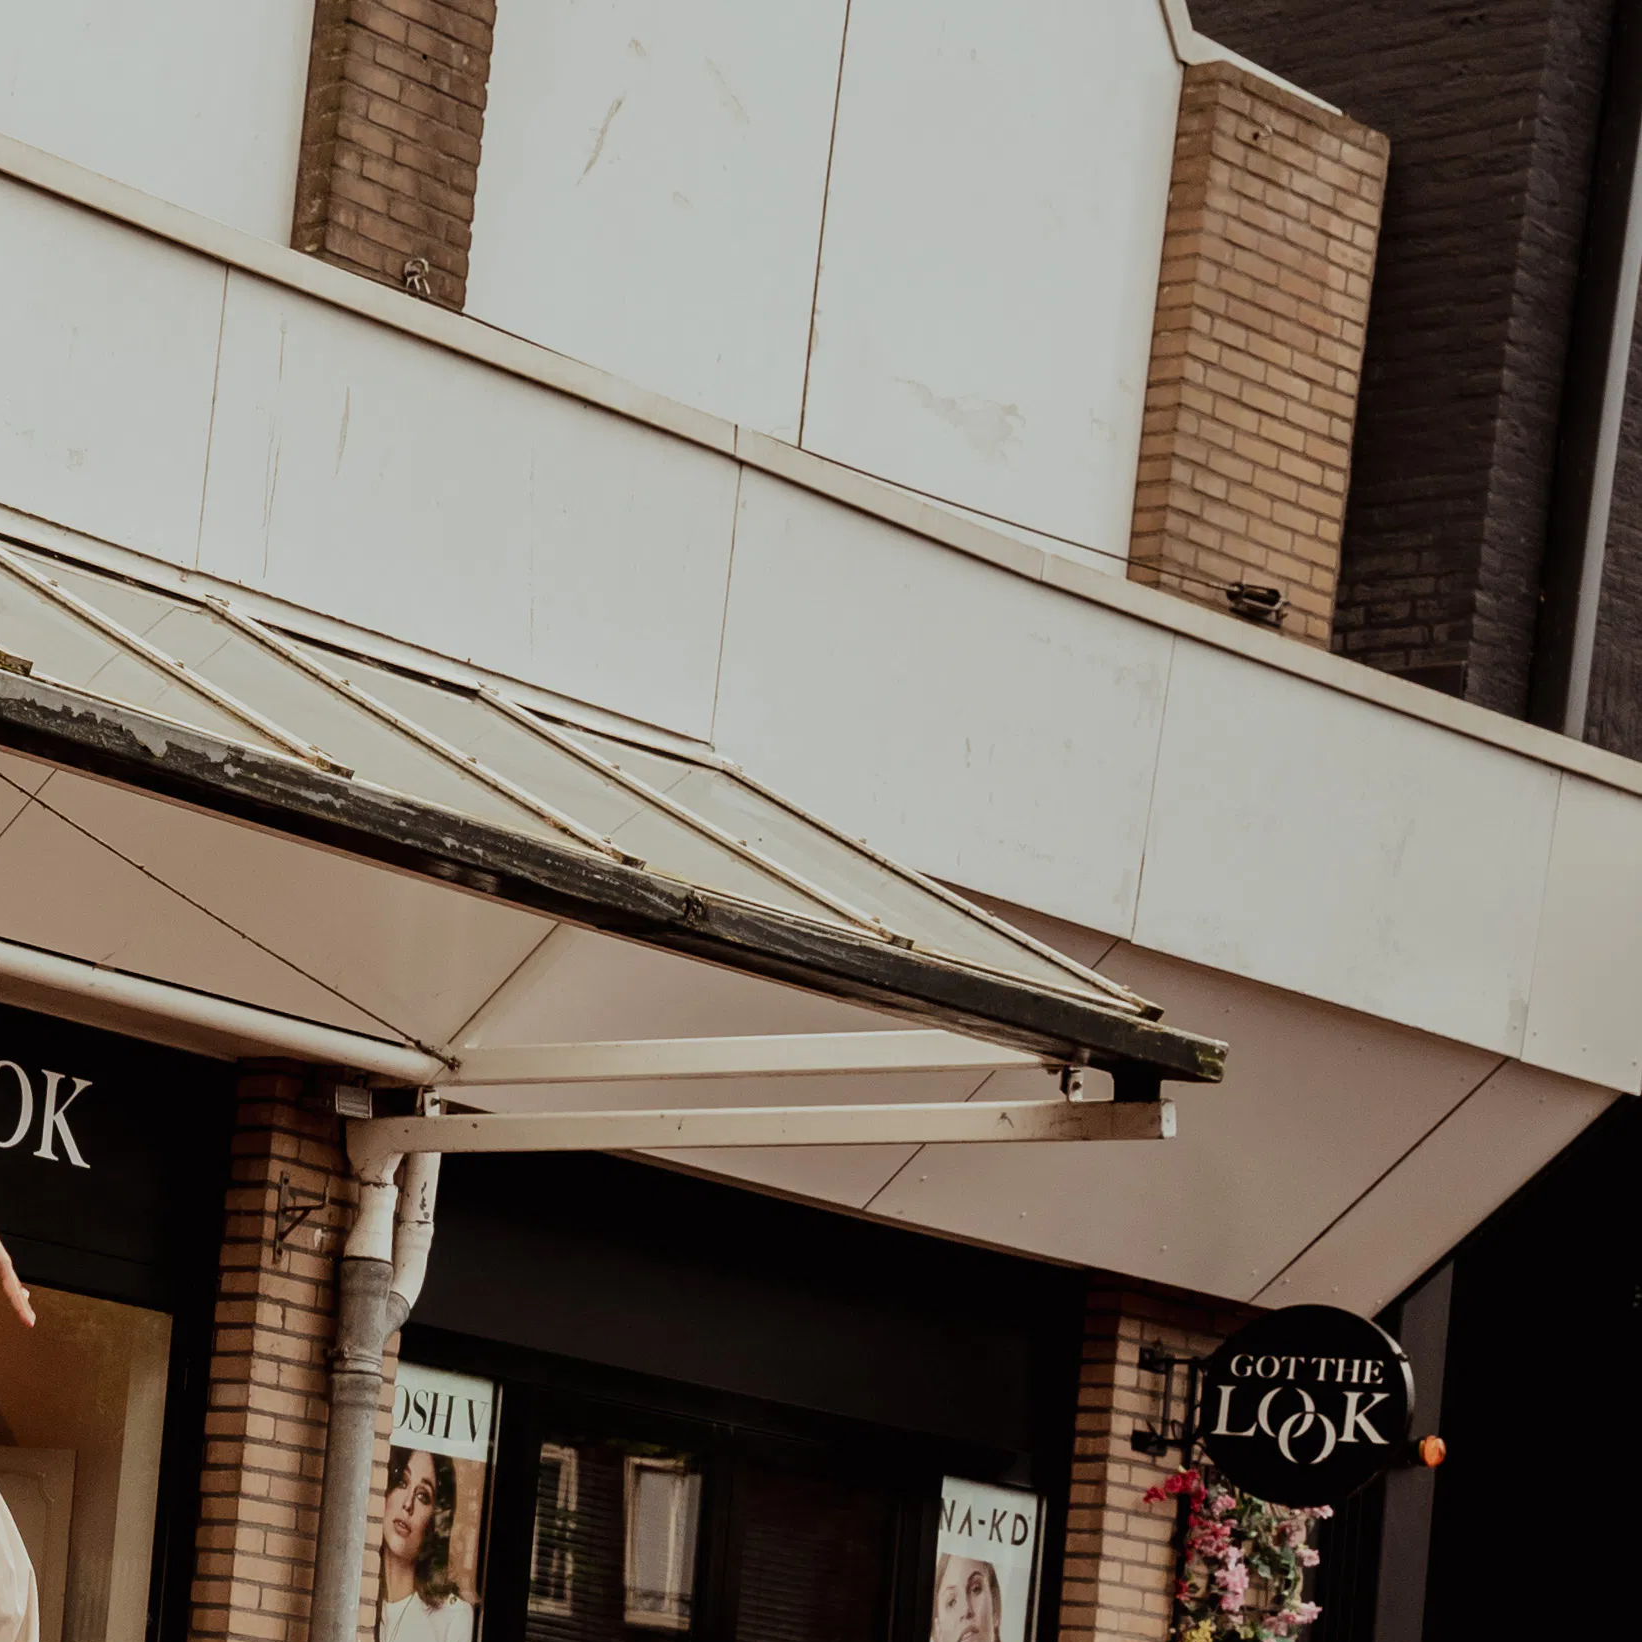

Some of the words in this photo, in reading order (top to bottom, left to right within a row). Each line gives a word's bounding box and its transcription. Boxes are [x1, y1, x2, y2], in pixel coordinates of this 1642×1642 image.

[1230, 1353, 1305, 1381] GOT
[1311, 1356, 1385, 1385] THE
[1210, 1384, 1391, 1465] LOOK
